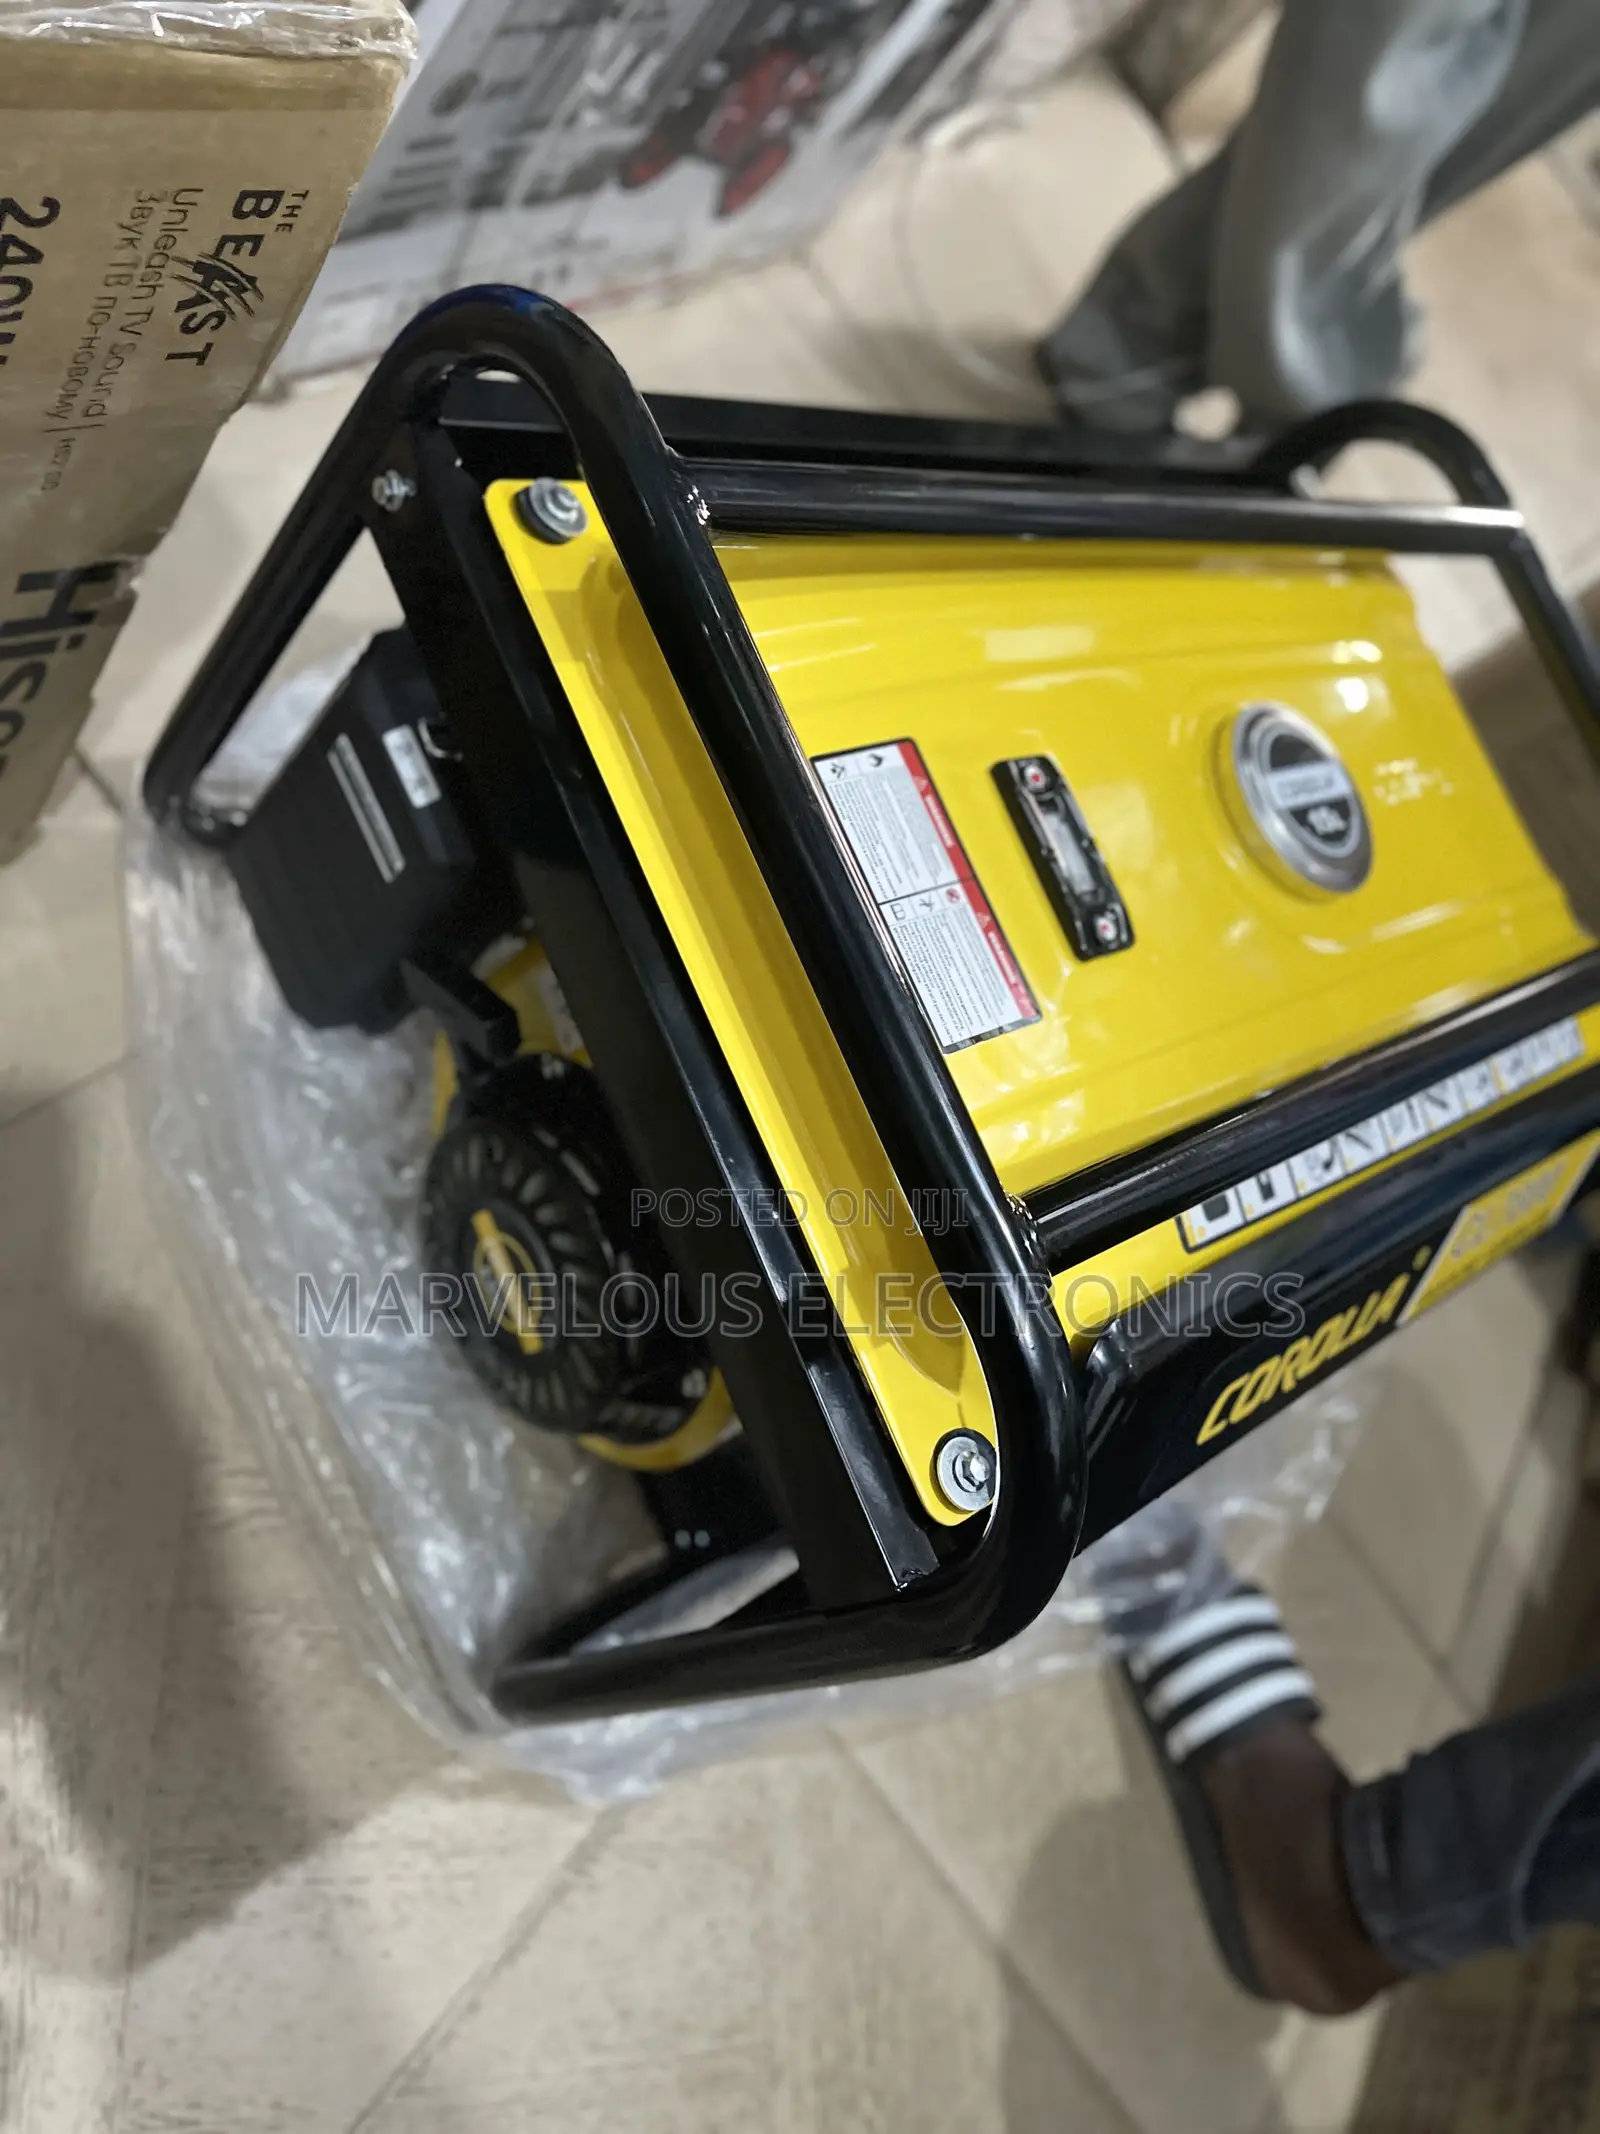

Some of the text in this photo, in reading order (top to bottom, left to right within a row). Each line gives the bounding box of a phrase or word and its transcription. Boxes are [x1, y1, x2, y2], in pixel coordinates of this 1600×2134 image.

[117, 190, 160, 250] Звук
[165, 189, 285, 366] BEAST
[275, 189, 309, 233] THE
[83, 187, 204, 418] Unleash TV Sound
[1196, 1271, 1410, 1446] COROLLA
